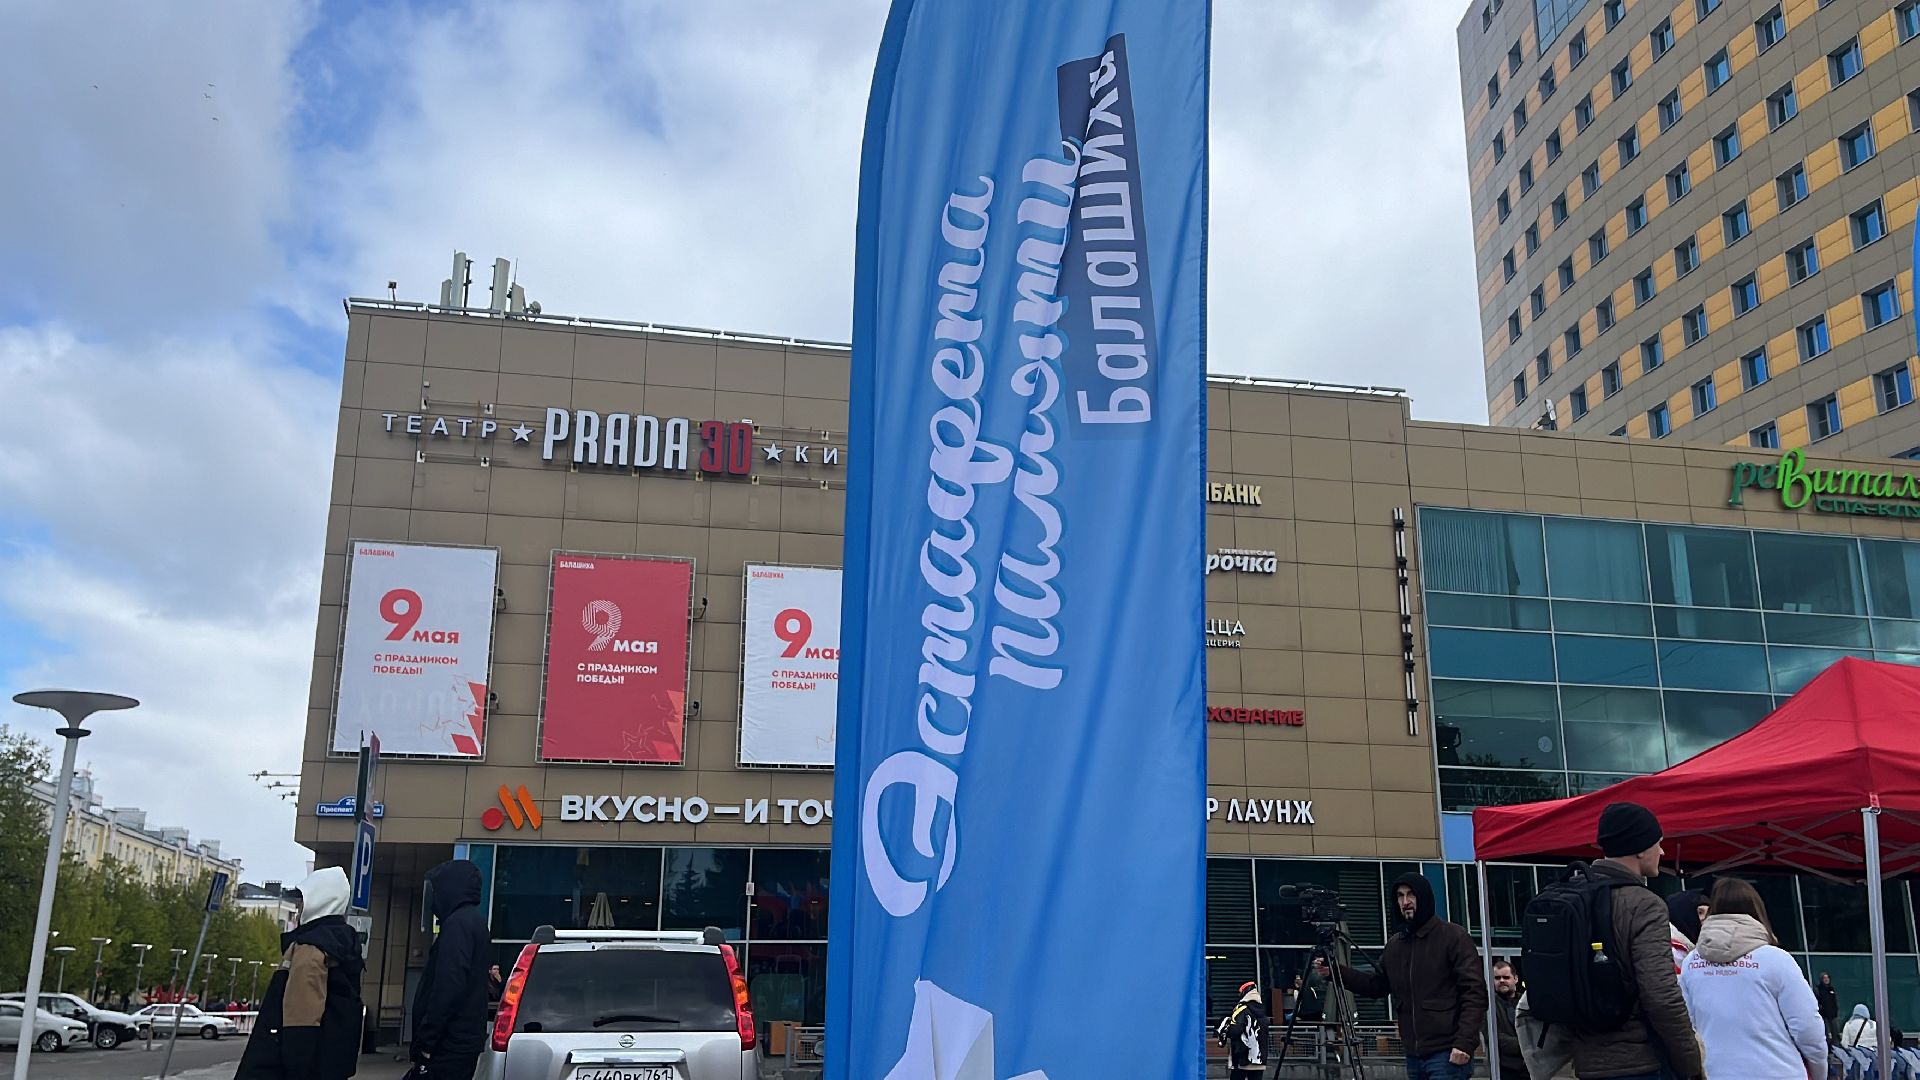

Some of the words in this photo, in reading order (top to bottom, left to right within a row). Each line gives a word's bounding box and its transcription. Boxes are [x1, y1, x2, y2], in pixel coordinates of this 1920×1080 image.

[1076, 50, 1151, 424] Балашиха
[989, 139, 1081, 689] памяти
[382, 413, 497, 438] ТЕАТР
[542, 407, 689, 471] PRADA
[795, 445, 838, 465] КИ
[1729, 448, 1920, 508] реВитал
[1816, 497, 1920, 518] СПА-КЛУ
[359, 549, 394, 557] БАЛАШИХА
[863, 175, 994, 917] Эстафета
[560, 561, 595, 570] БАЛАШИХА
[1205, 554, 1278, 576] рочка
[380, 589, 423, 641] 9
[412, 630, 460, 644] мая
[582, 600, 621, 651] 9
[613, 640, 658, 653] мая
[774, 608, 812, 658] 9
[1206, 619, 1245, 636] ЦЦА
[373, 665, 423, 675] ПОБЕДЫ!
[374, 654, 382, 662] С
[384, 654, 458, 665] ПРАЗДНИКОМ
[577, 663, 586, 671] С
[588, 663, 657, 674] ПРАЗДНИКОМ
[577, 674, 625, 684] ПОБЕДЫ!
[772, 670, 779, 678] С
[782, 670, 839, 681] ПРАЗДНИКО
[771, 682, 816, 691] ПОБЕДЫ!
[1207, 706, 1304, 726] ХОВАНИЕ
[744, 798, 769, 824] И
[777, 799, 833, 826] ТО
[1206, 797, 1219, 820] Р
[1227, 799, 1315, 824] ЛАУНЖ
